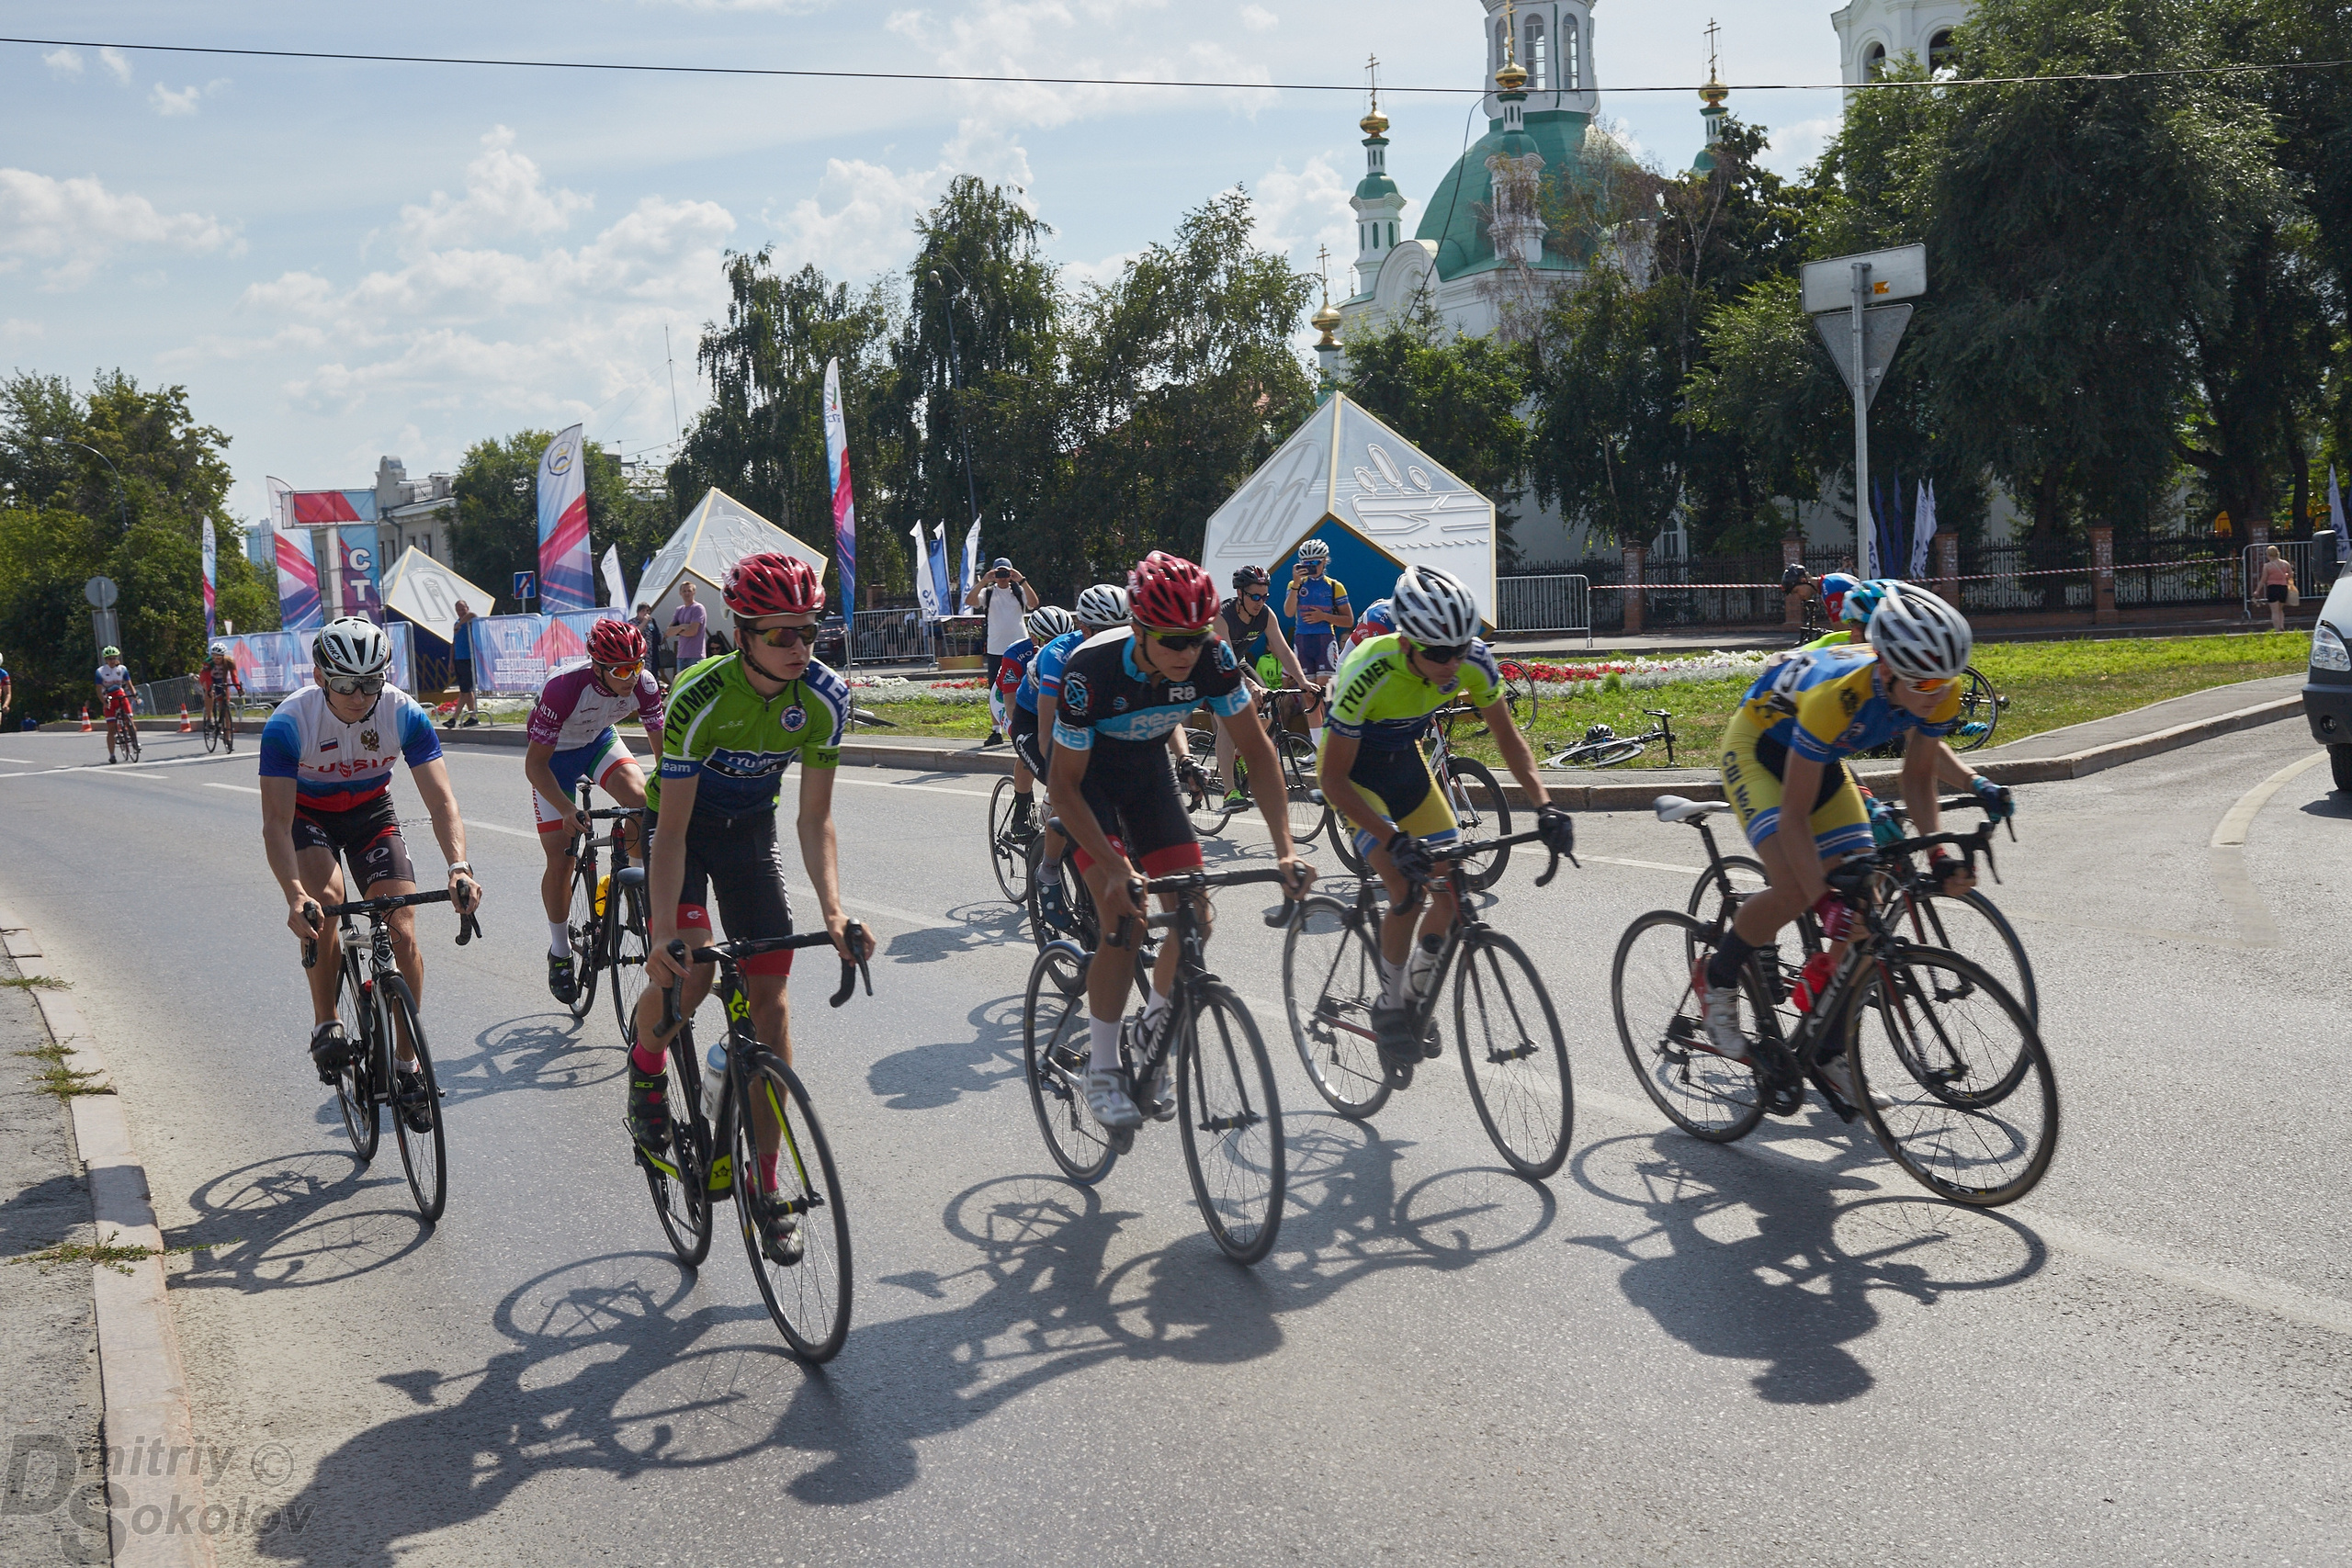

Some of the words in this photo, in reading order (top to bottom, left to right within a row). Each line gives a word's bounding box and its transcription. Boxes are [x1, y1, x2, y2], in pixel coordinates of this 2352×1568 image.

[322, 630, 345, 661] S-WORKS
[663, 670, 725, 747] TYUMEN
[815, 666, 850, 733] TEA
[728, 756, 780, 769] TYUME
